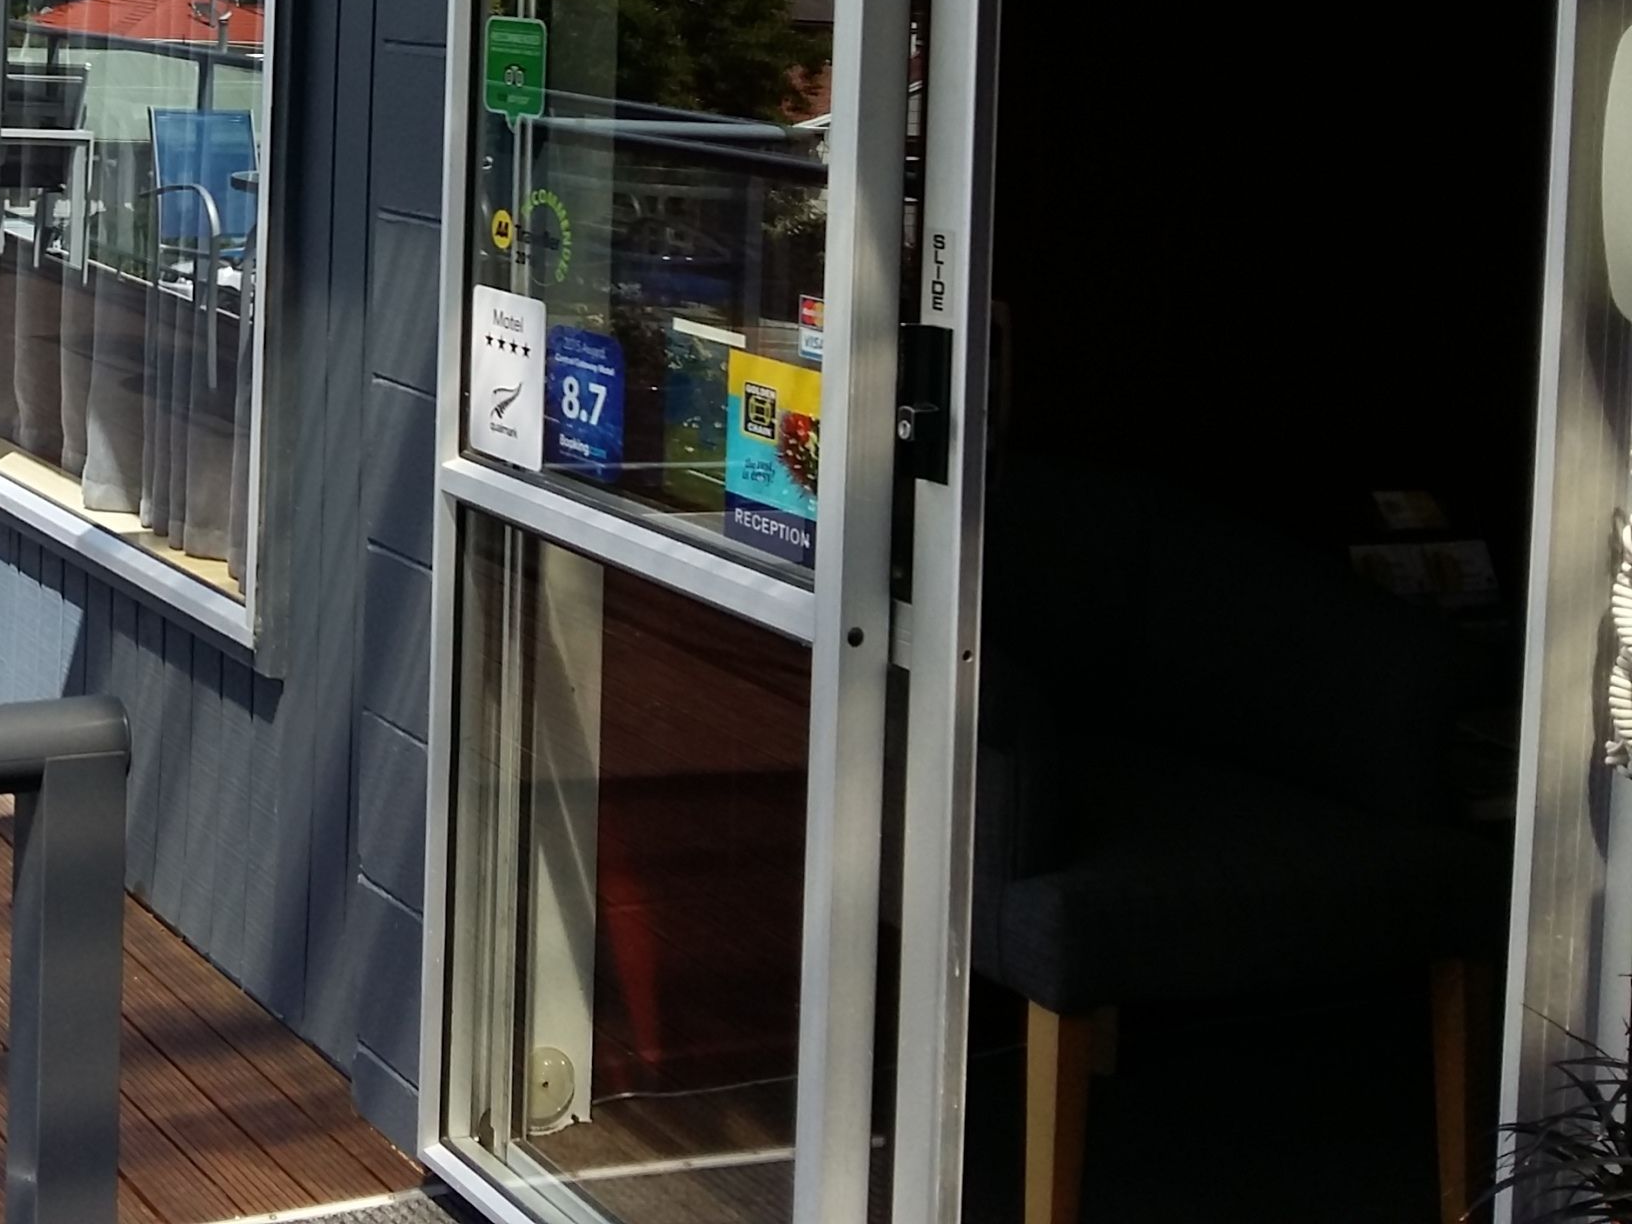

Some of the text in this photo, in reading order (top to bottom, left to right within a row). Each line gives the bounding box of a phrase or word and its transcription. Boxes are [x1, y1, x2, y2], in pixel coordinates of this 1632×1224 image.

[932, 234, 945, 311] SLIDE
[493, 309, 524, 333] Motel
[561, 376, 607, 426] 8.7
[734, 507, 810, 549] RECEPTION
